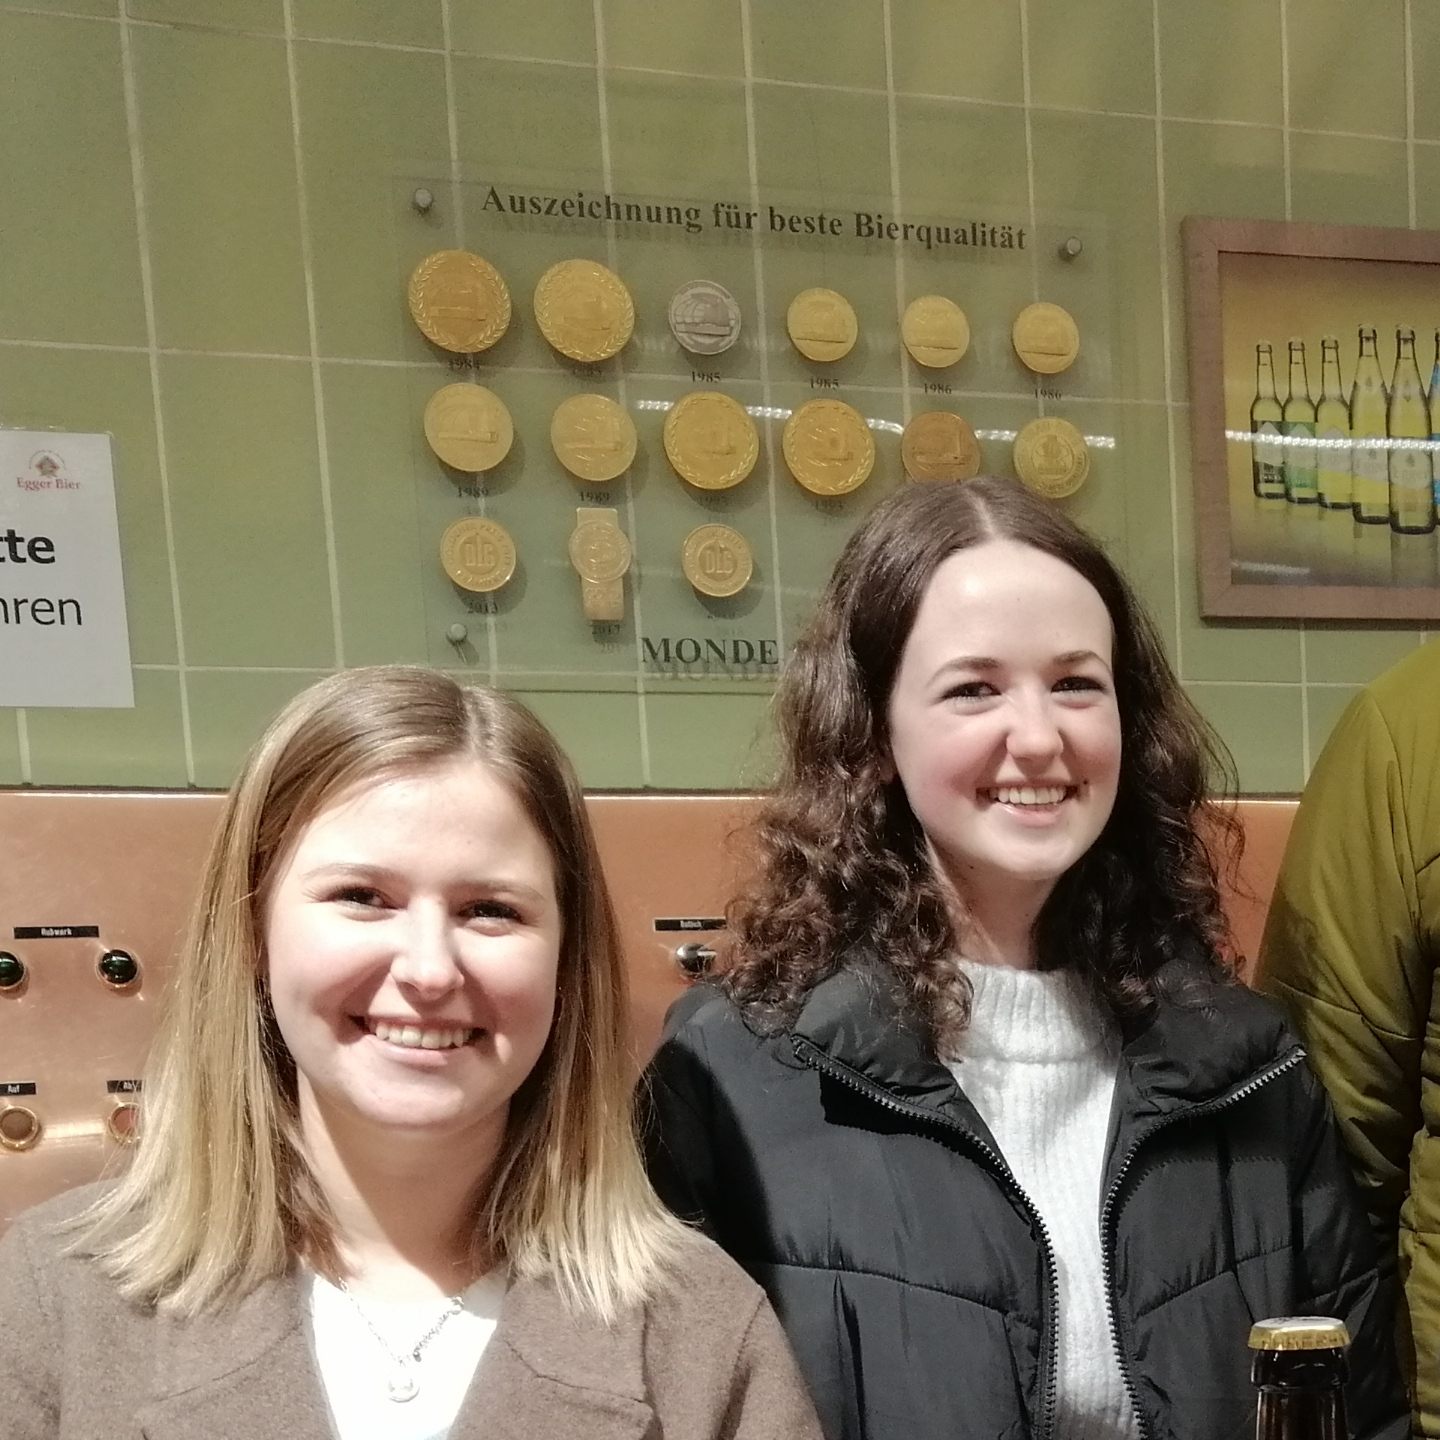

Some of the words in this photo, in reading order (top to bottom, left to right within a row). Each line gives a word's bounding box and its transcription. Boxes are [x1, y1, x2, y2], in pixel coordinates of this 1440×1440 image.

[482, 186, 702, 233] Auszeichnung
[712, 202, 757, 230] für
[769, 206, 842, 236] beste
[854, 212, 1026, 249] Bierqualität
[690, 371, 721, 384] 1985
[923, 382, 952, 395] 1986
[17, 477, 51, 491] Egger
[55, 478, 81, 490] Bier
[641, 637, 780, 665] MONDE
